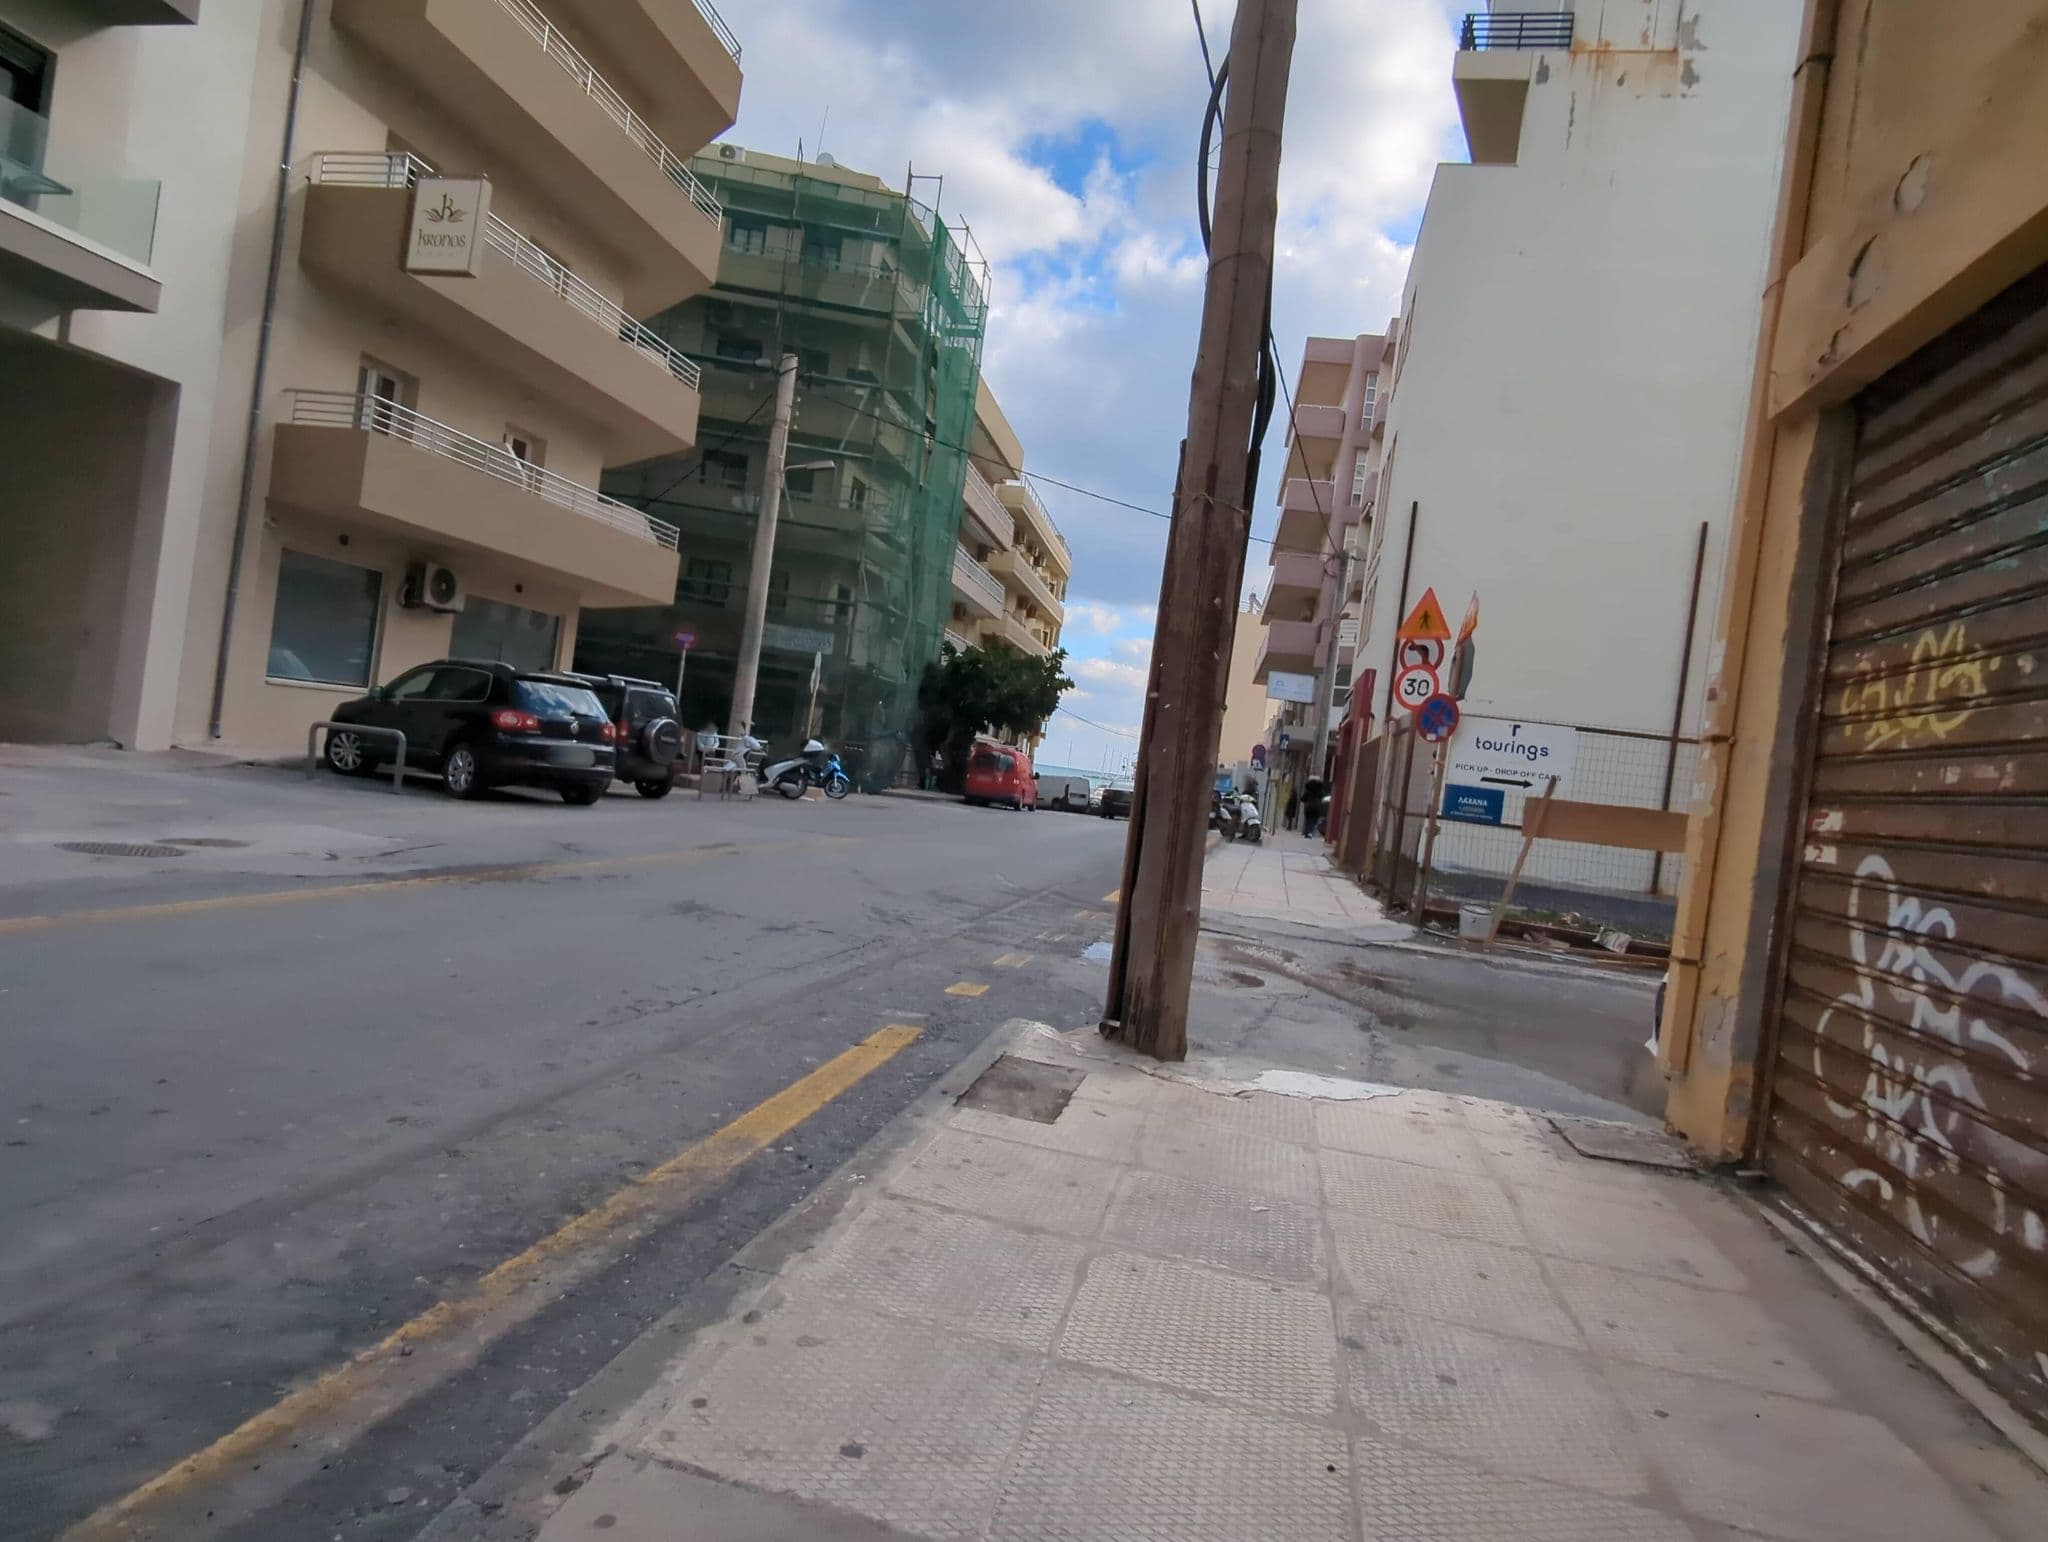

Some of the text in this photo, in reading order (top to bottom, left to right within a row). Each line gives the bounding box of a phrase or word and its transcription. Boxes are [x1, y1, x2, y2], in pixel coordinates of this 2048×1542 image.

[1404, 678, 1430, 697] 30
[1475, 736, 1549, 761] tourings
[1455, 762, 1475, 772] PICK
[1477, 765, 1489, 773] UP
